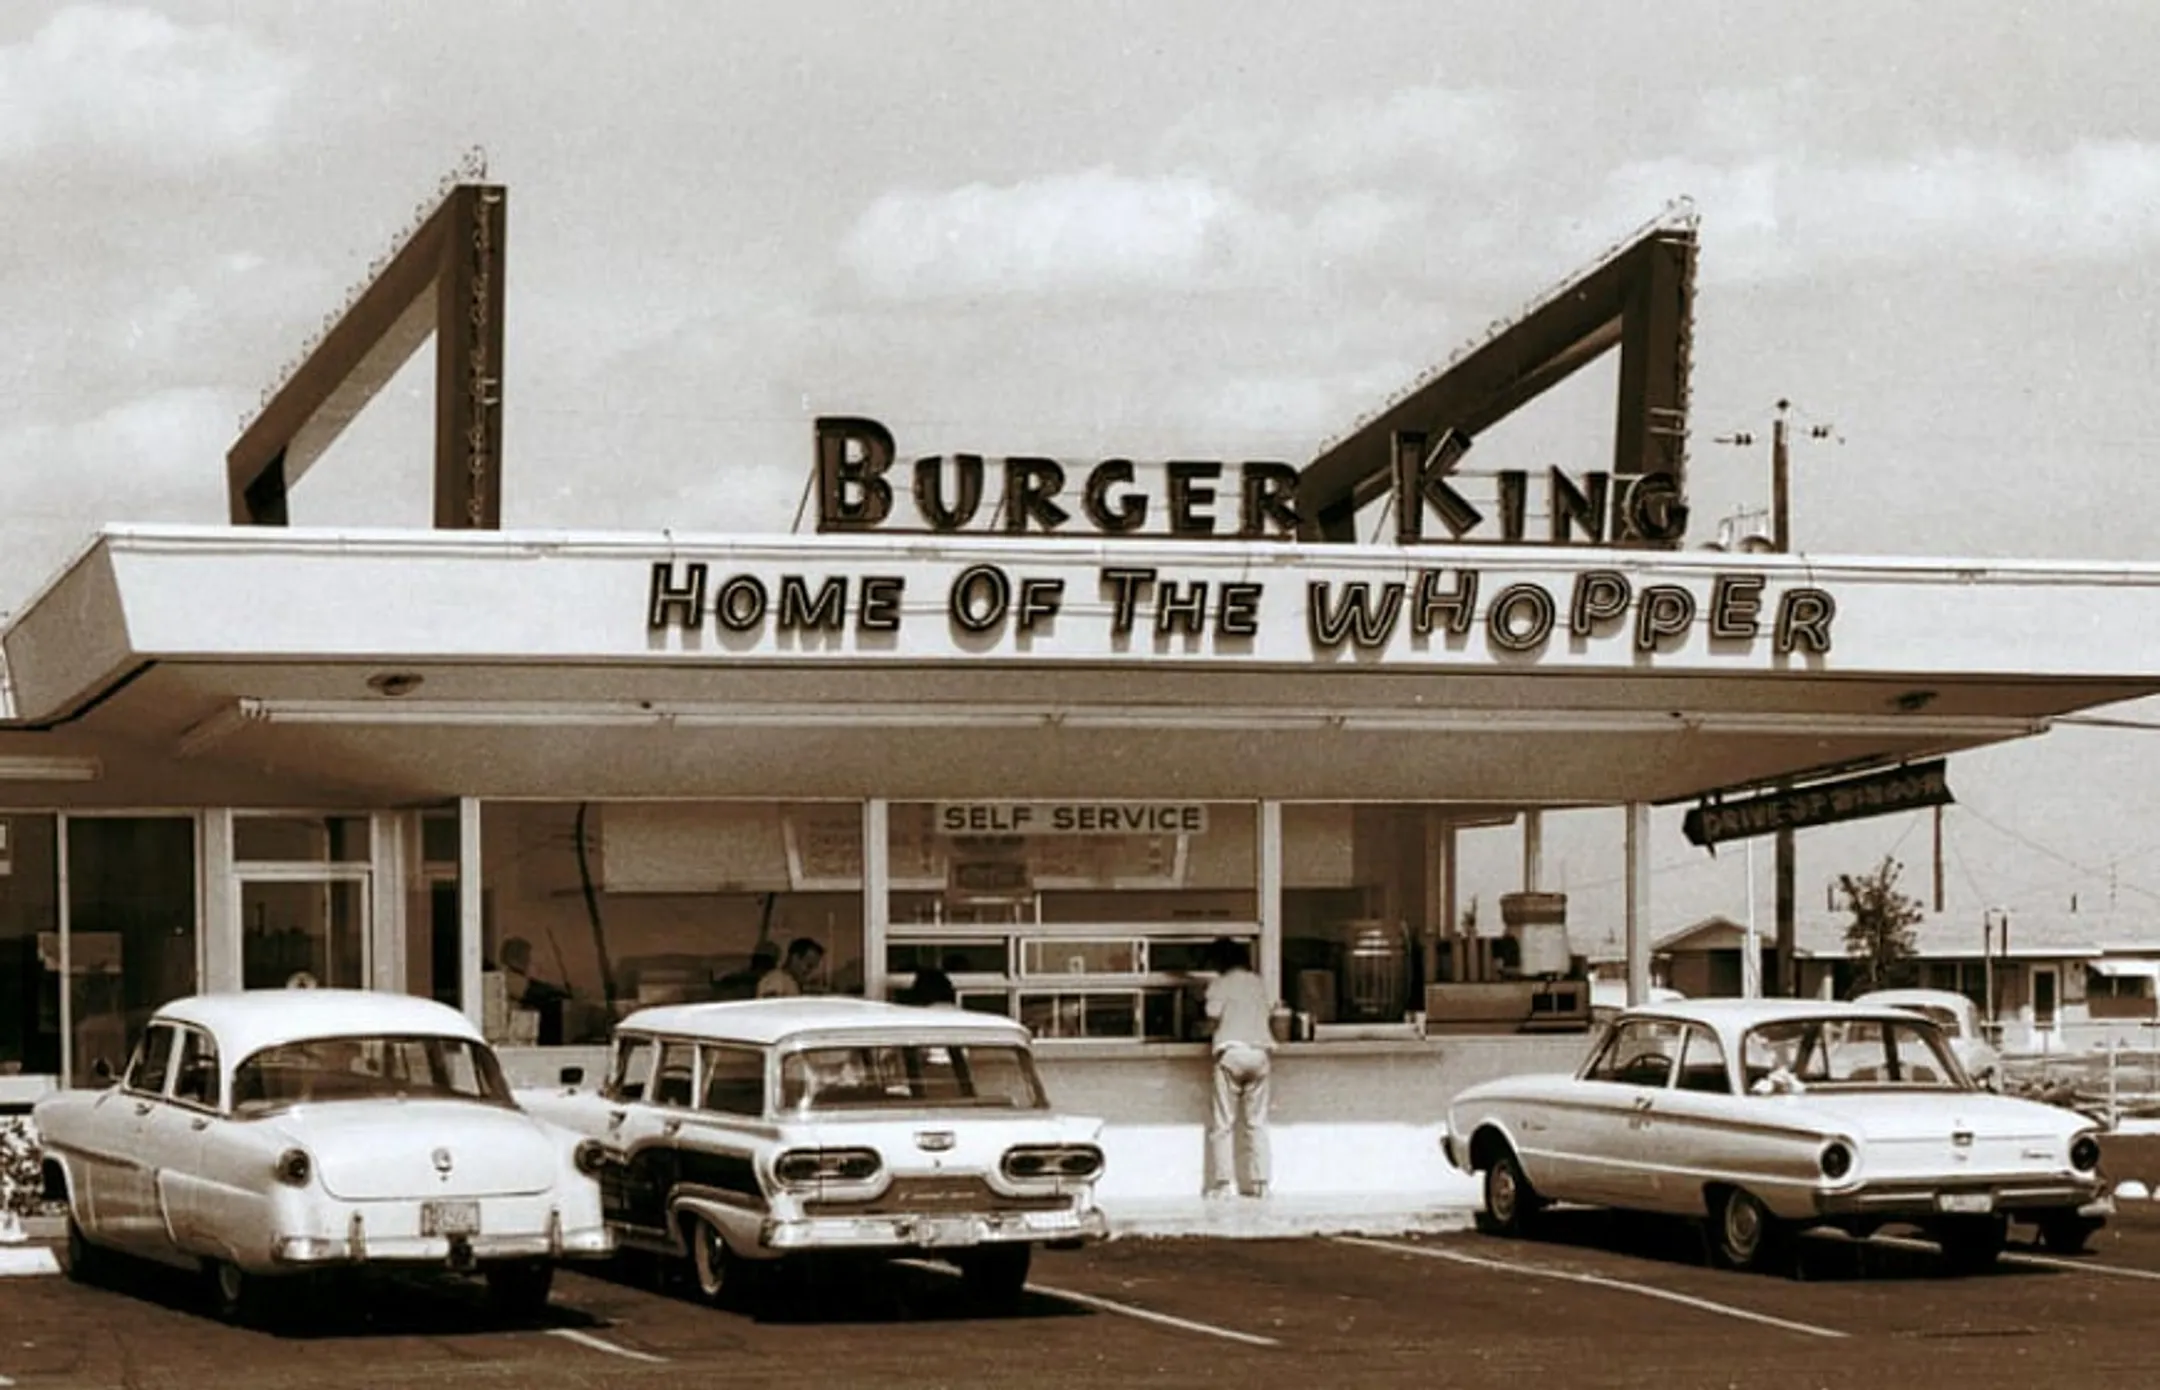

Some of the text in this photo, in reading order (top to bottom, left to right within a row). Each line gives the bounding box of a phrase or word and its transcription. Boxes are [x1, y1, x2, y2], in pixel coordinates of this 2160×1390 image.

[814, 415, 1688, 540] BURGER KING
[647, 563, 1836, 654] HOME OF THE WHOPPER
[943, 806, 1203, 831] SELF SERVICE
